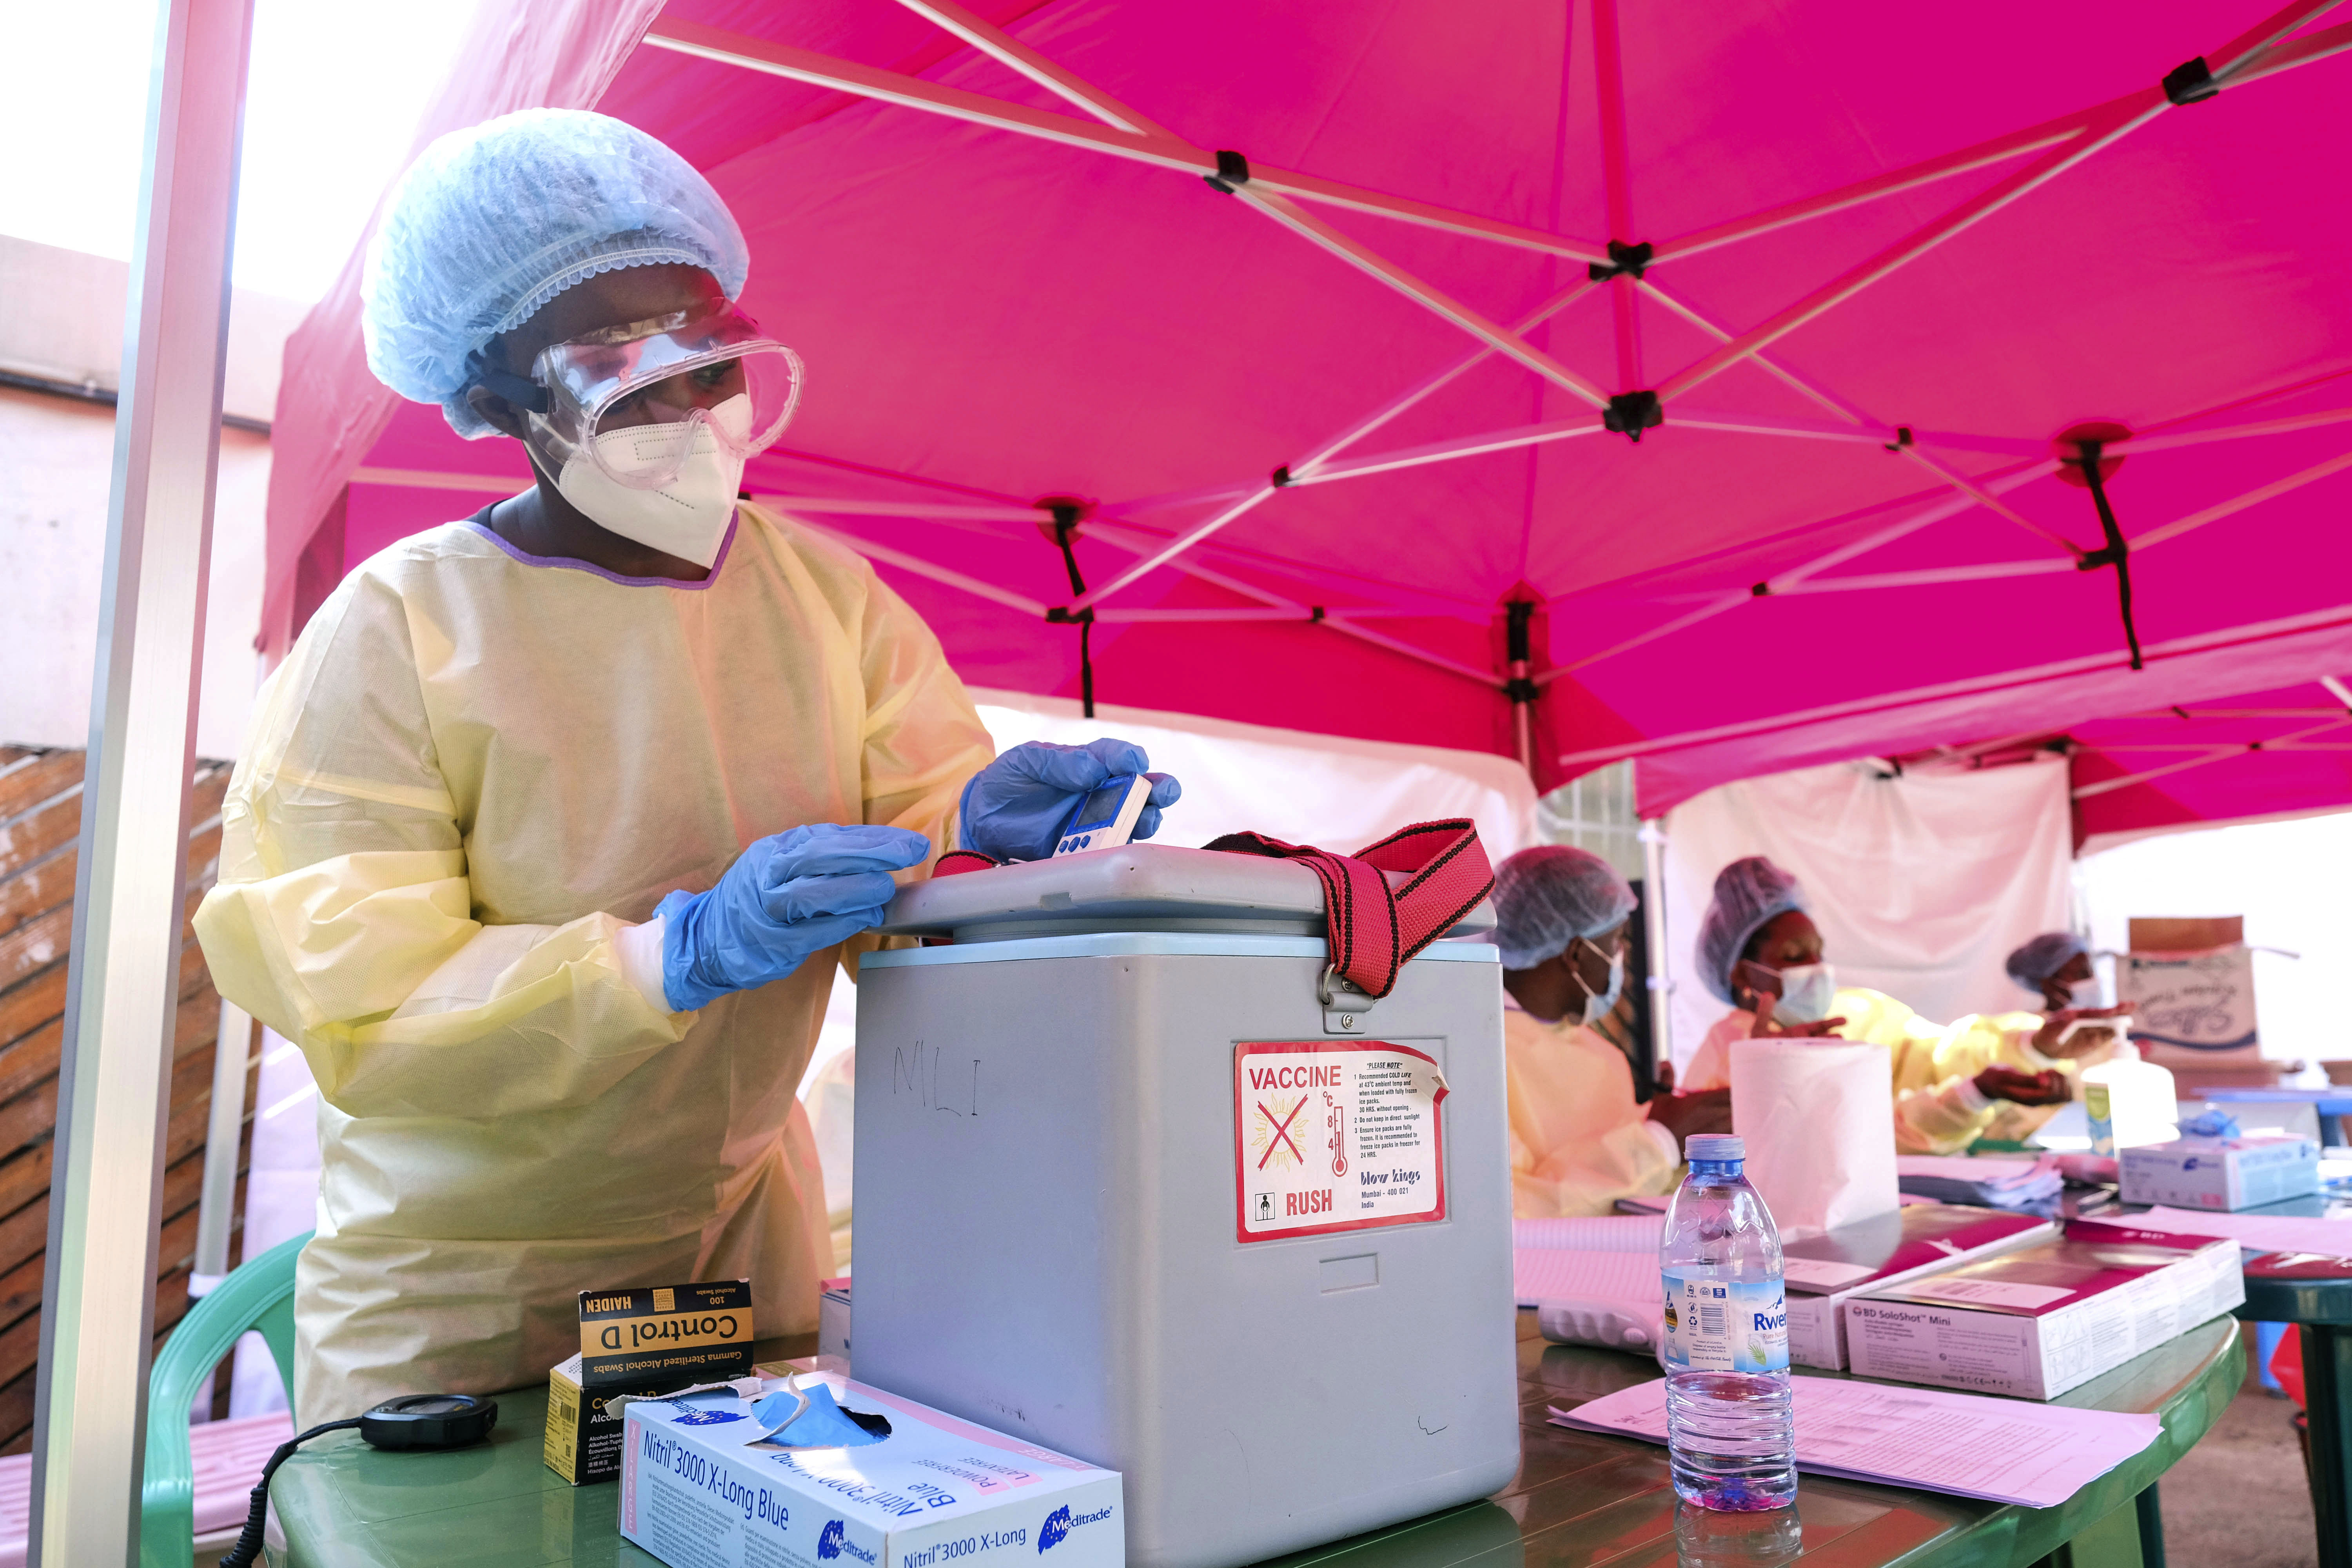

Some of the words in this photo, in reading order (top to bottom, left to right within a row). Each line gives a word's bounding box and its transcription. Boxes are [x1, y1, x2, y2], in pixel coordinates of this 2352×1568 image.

[1249, 1065, 1341, 1090] VACCINE
[1328, 1116, 1333, 1127] 8
[1328, 1138, 1334, 1150] 4
[1361, 1172, 1388, 1185] blow
[1392, 1169, 1420, 1185] kings
[1287, 1189, 1332, 1216] RUSH
[1361, 1190, 1381, 1198] Mumbai
[586, 1296, 632, 1313] HAIDEN
[710, 1296, 724, 1305] 100
[1863, 1308, 1876, 1317] BD
[1879, 1310, 1926, 1323] SoloShot™
[1929, 1316, 1951, 1326] Mini
[601, 1326, 622, 1349] D
[631, 1316, 737, 1347] Control
[664, 1355, 705, 1367] Sterilized
[708, 1351, 742, 1360] Gamma
[594, 1363, 624, 1373] Swabs
[626, 1360, 661, 1371] Alcohol
[911, 1459, 997, 1488] POWDERFREE
[958, 1457, 1029, 1480] LATEXFREE
[675, 1446, 705, 1486] 3000
[708, 1463, 754, 1520] X-Long
[758, 1488, 789, 1530] Blue
[907, 1483, 957, 1508] Blue
[941, 1537, 976, 1561] 3000
[980, 1528, 1026, 1552] X-Long
